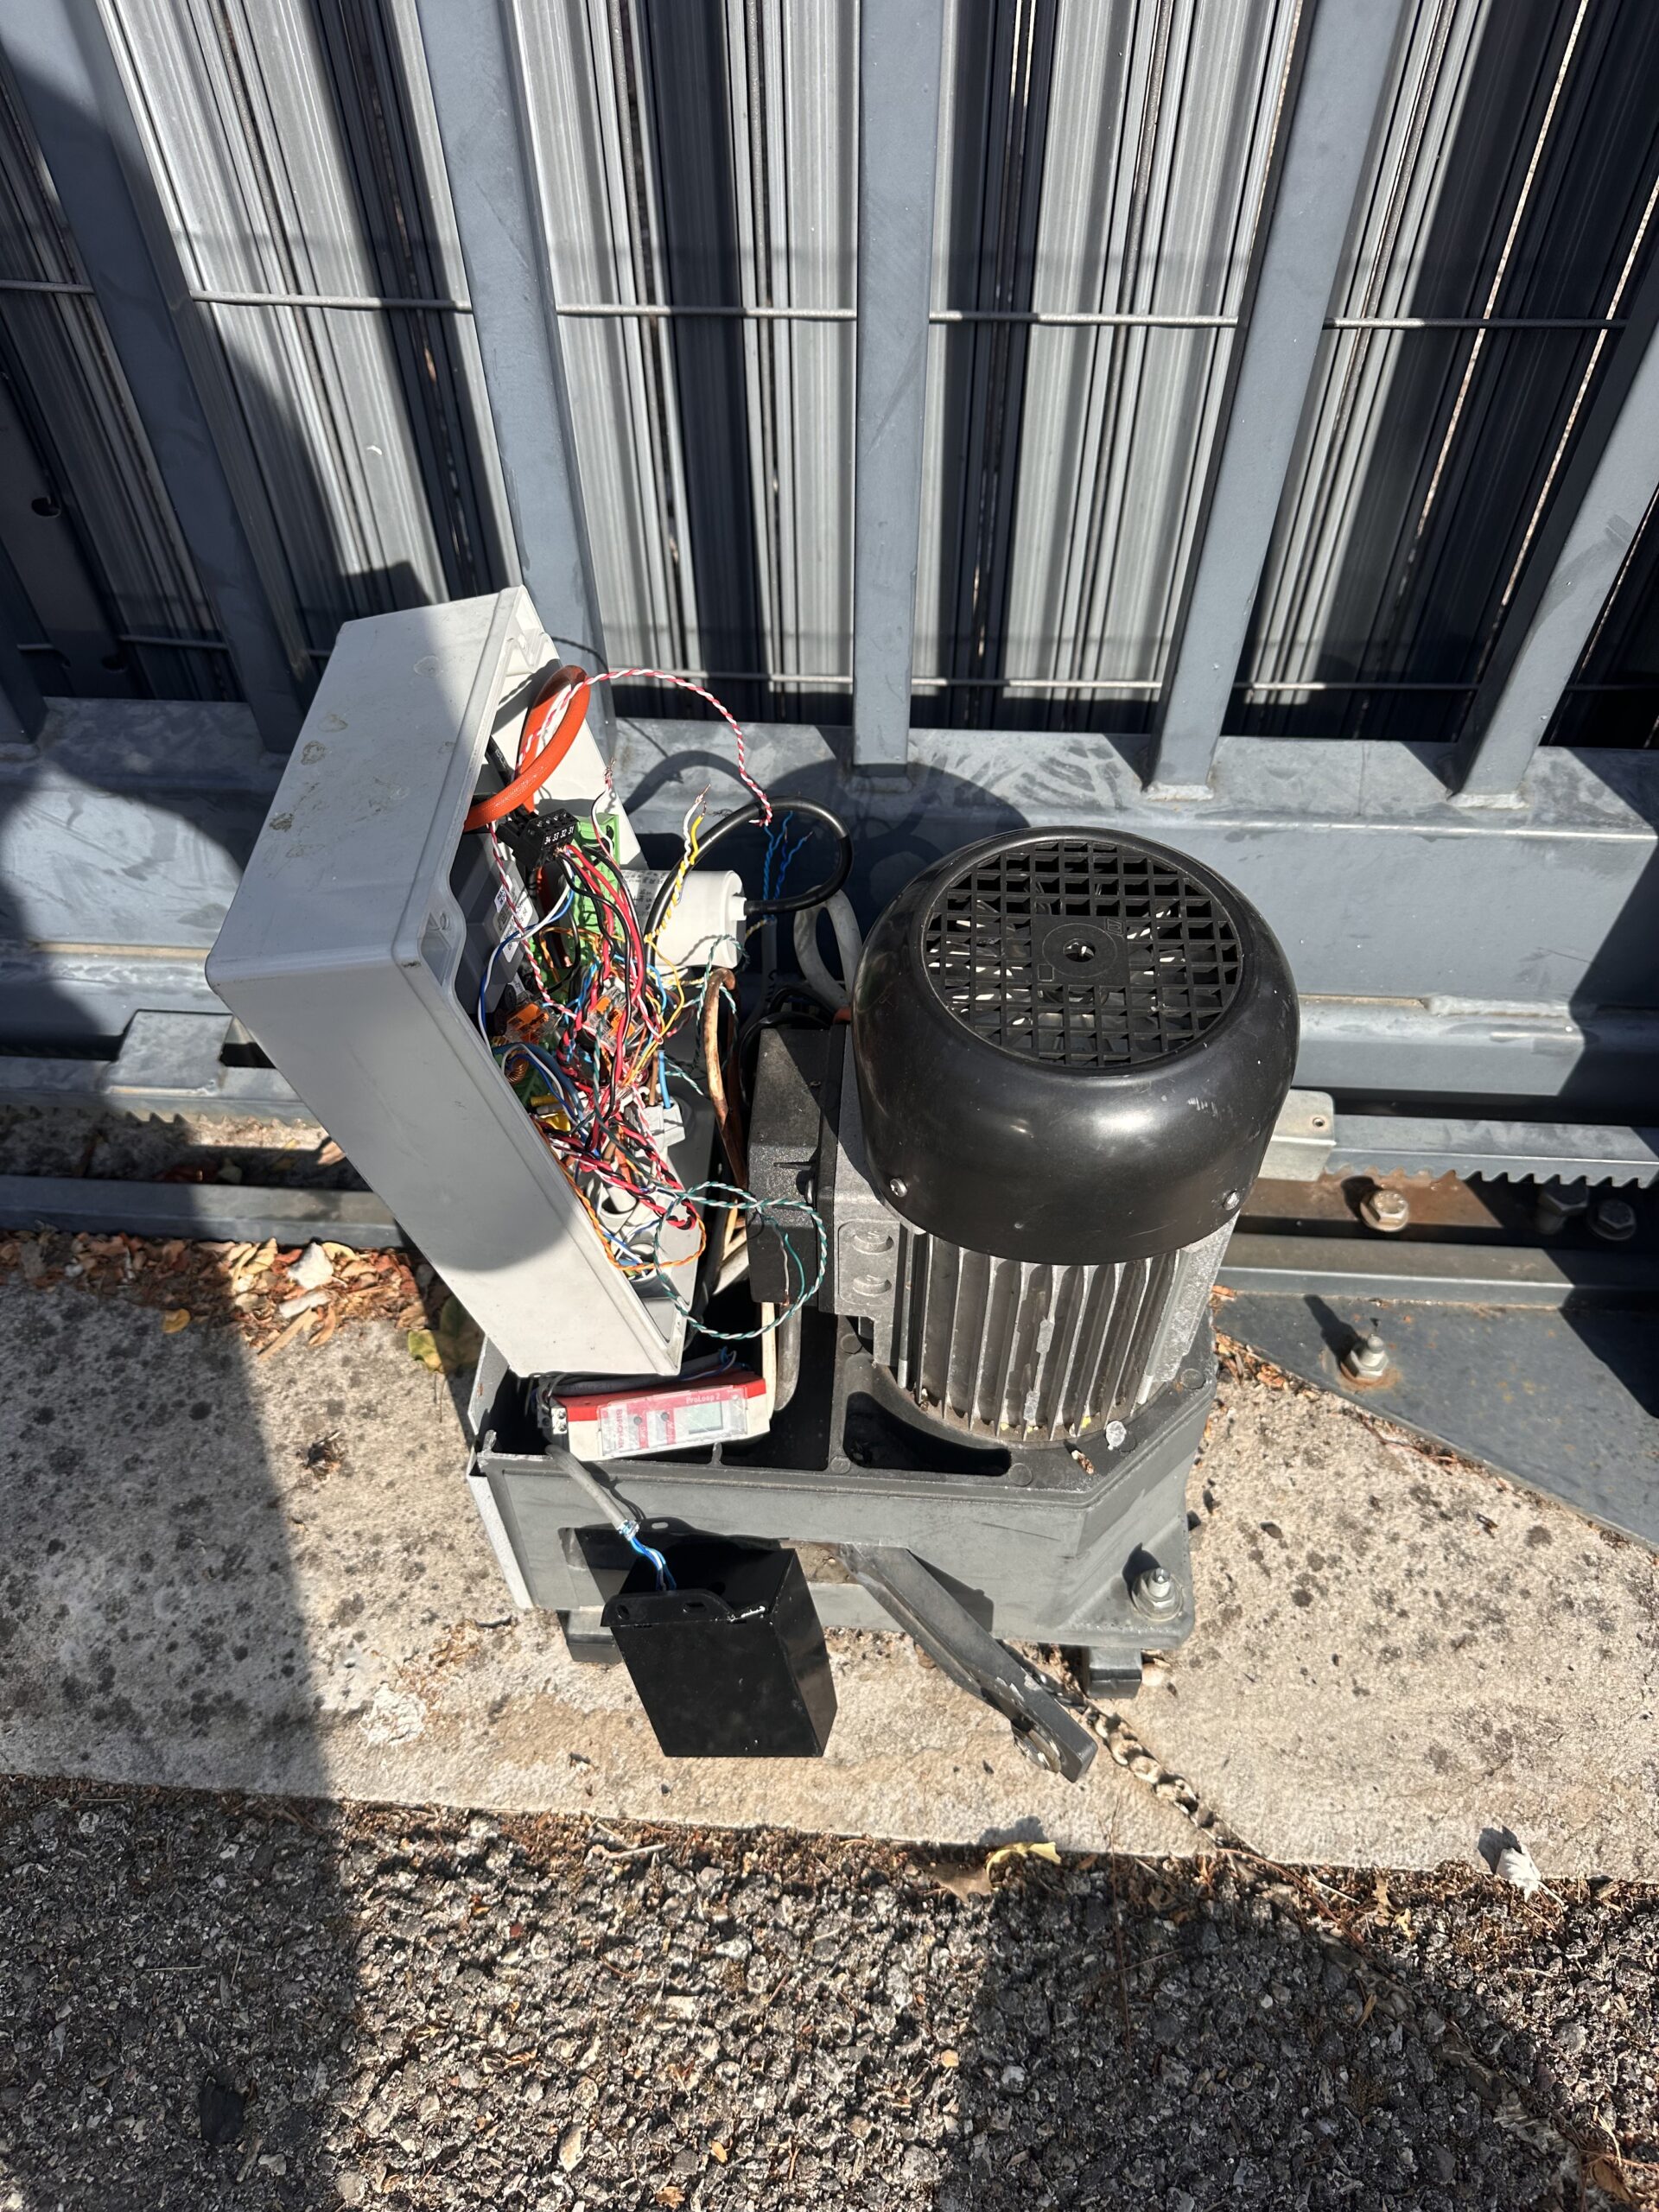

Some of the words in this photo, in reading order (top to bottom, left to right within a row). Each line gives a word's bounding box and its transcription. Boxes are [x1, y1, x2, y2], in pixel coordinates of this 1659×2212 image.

[544, 836, 551, 845] 34
[552, 831, 560, 842] 33
[560, 829, 568, 838] 32
[568, 825, 575, 835] 31
[685, 1395, 715, 1404] ProLoop
